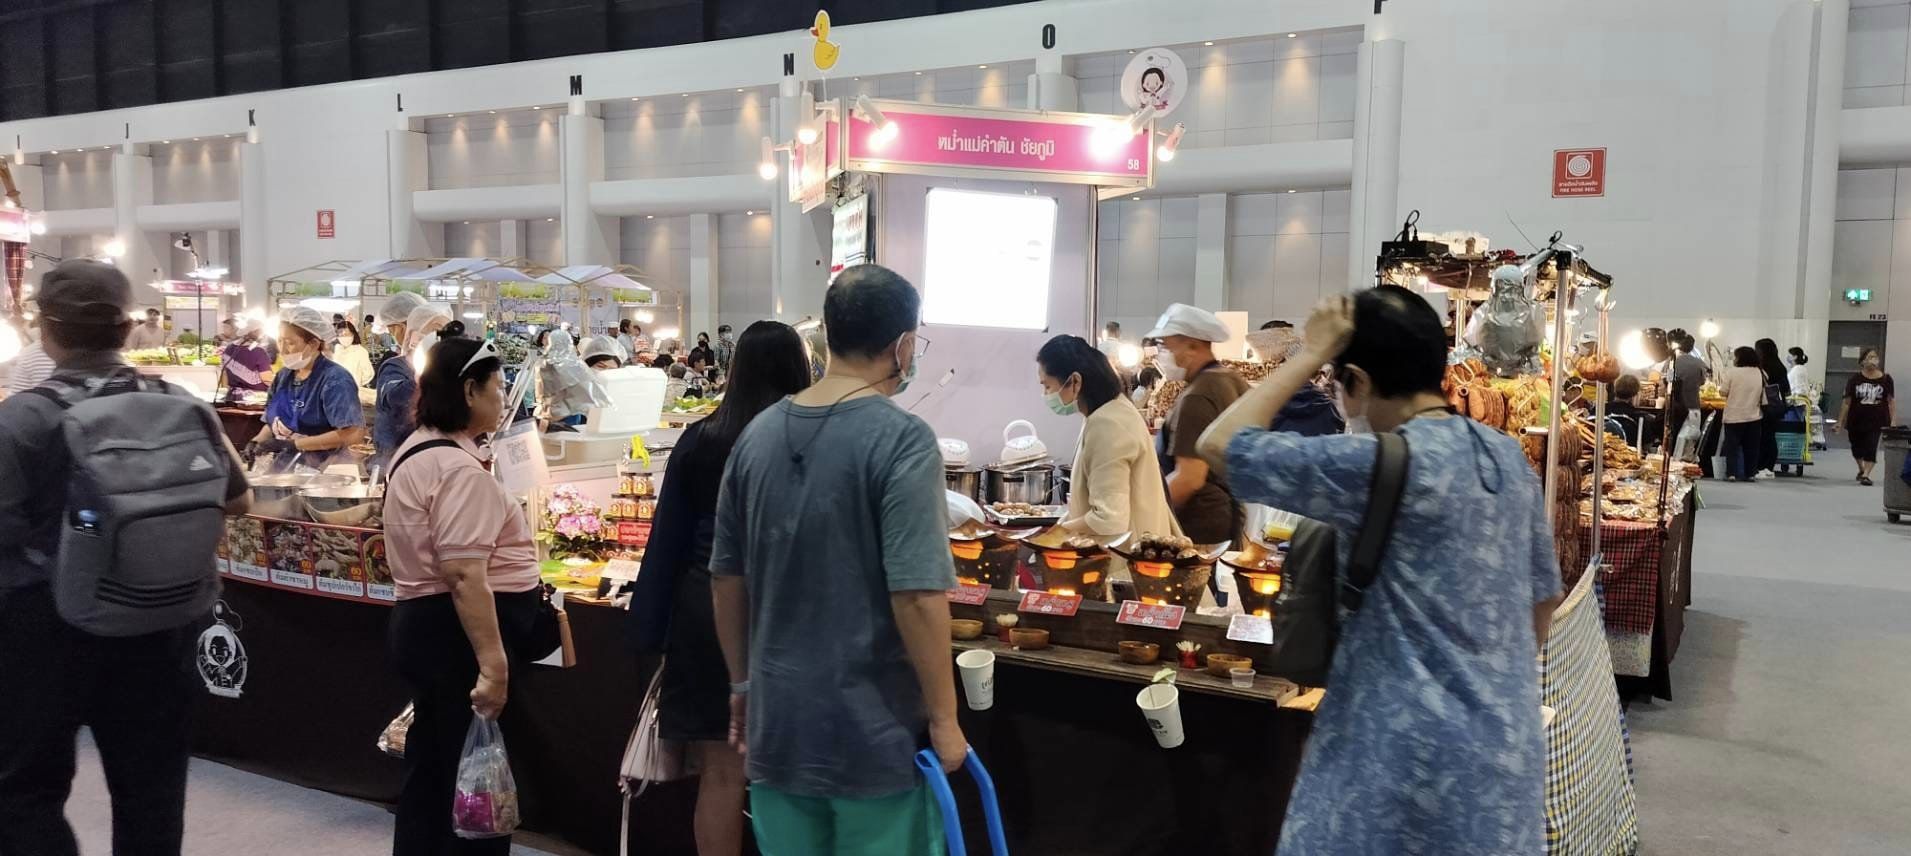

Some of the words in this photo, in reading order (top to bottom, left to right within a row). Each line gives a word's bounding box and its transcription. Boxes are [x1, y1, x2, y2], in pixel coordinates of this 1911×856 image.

[1042, 23, 1056, 50] O
[784, 53, 795, 76] N
[570, 75, 583, 96] M
[397, 93, 404, 112] L
[248, 108, 257, 127] K
[1020, 137, 1055, 161] ชัยภูมิ
[1127, 158, 1140, 171] 58
